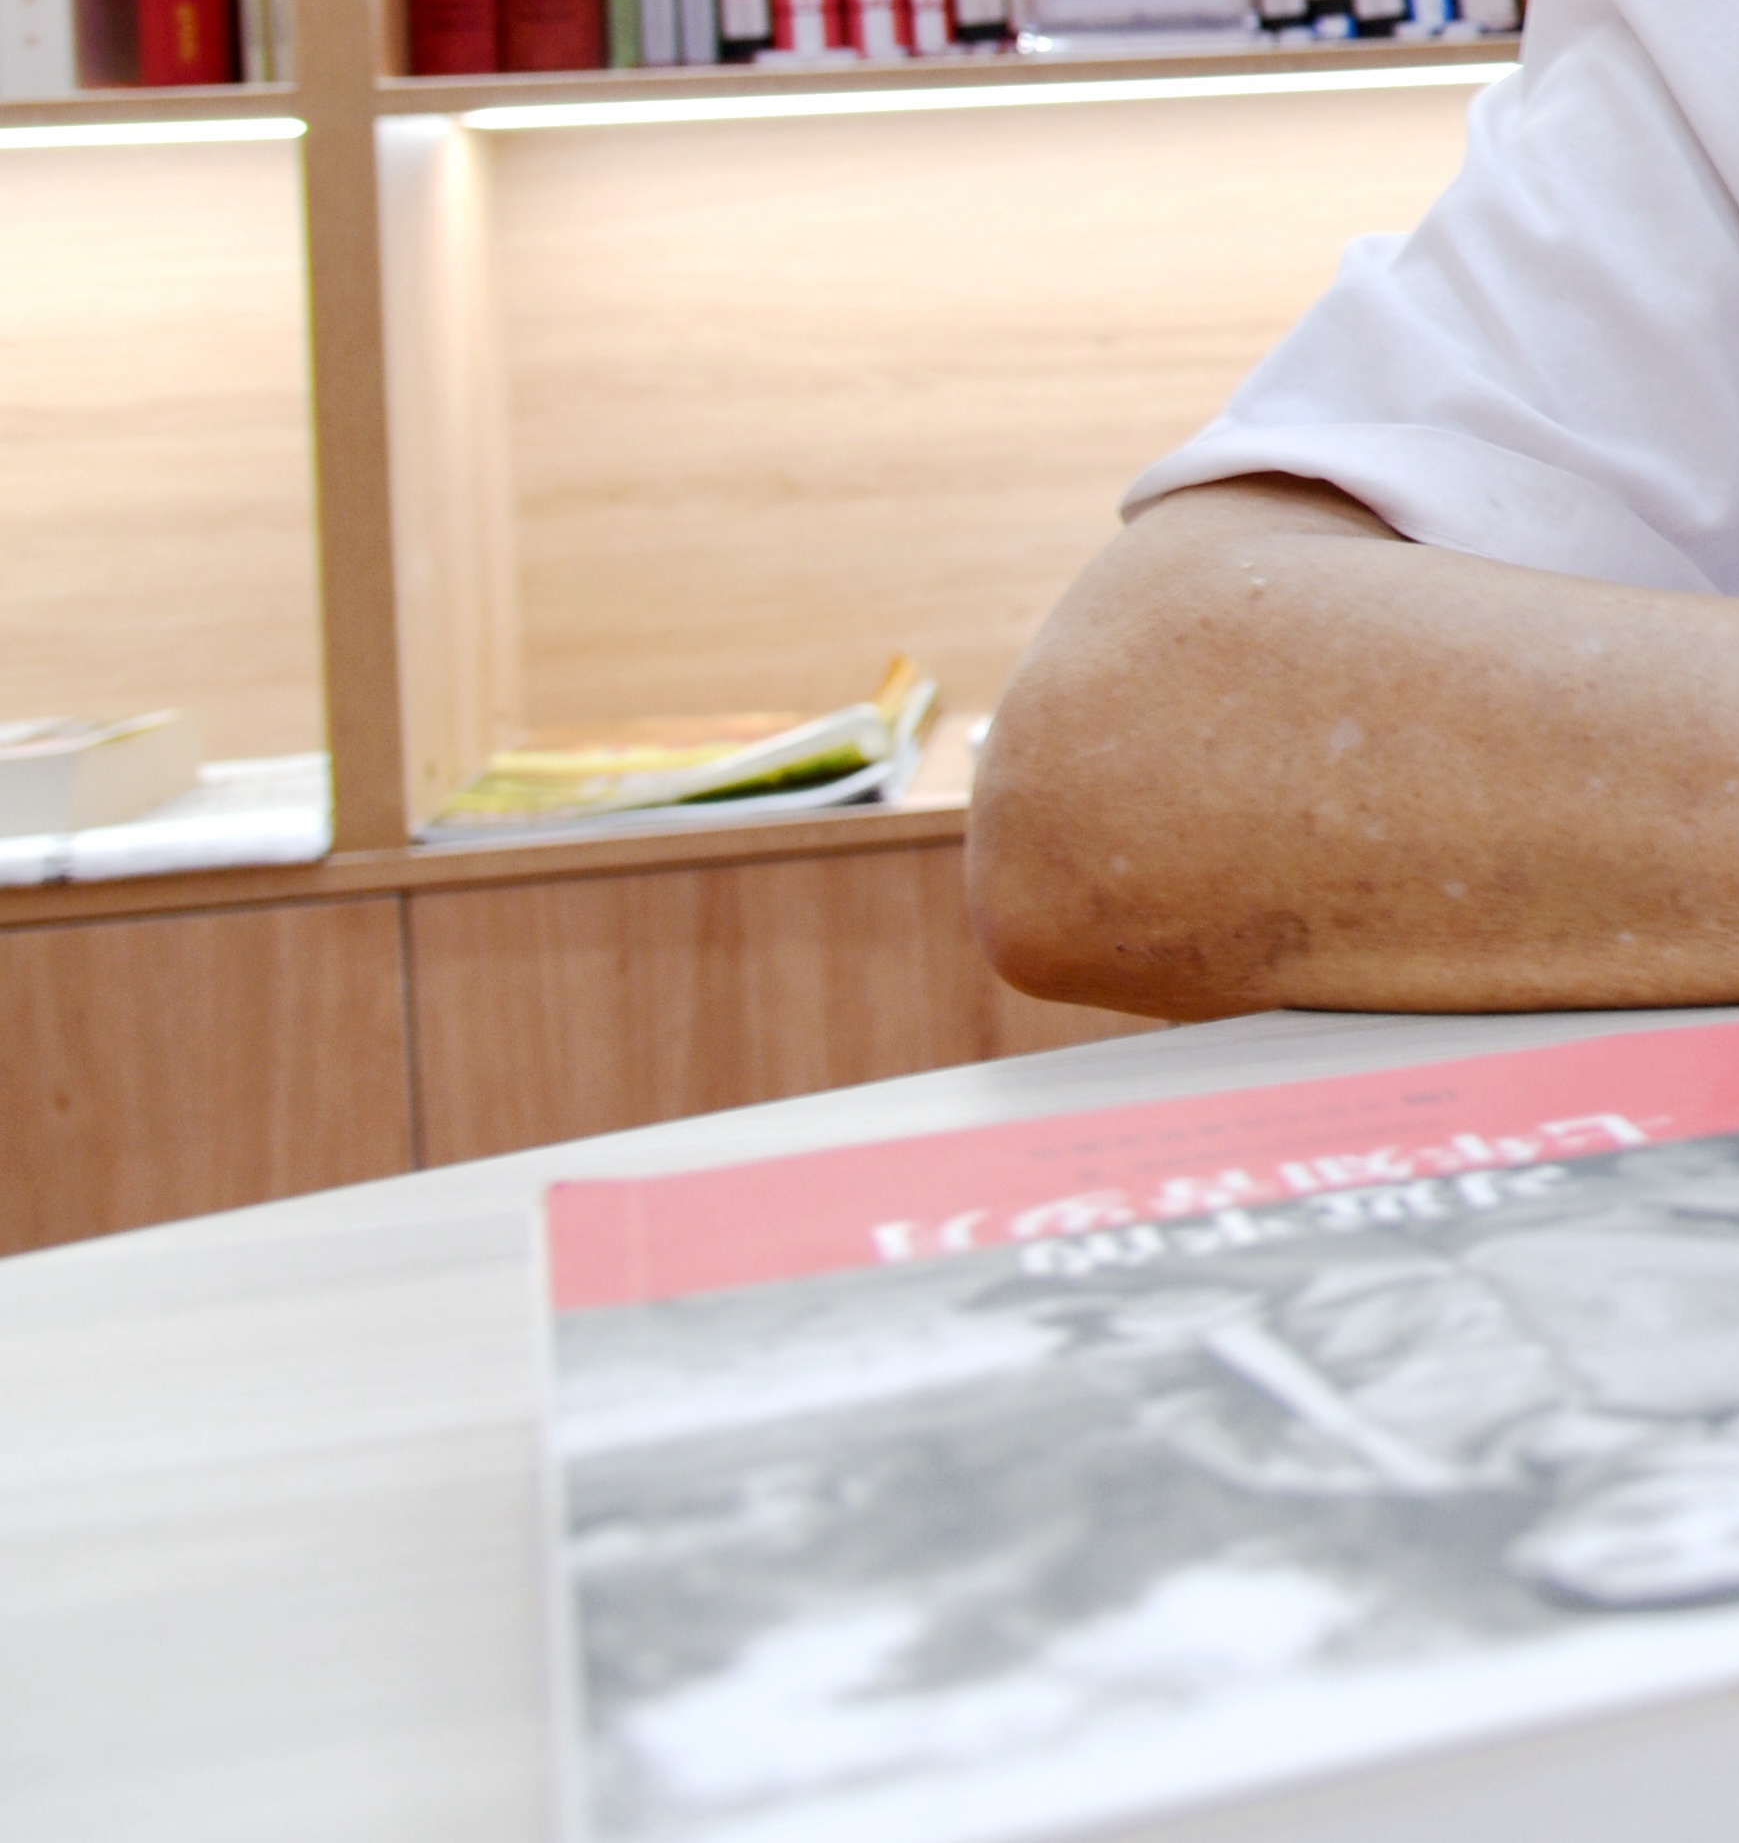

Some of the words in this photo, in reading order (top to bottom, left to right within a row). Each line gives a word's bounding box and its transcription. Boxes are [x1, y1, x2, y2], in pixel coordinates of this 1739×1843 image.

[872, 1111, 1673, 1261] 七年知青岁月
[1014, 1160, 1573, 1279] 习近平的
